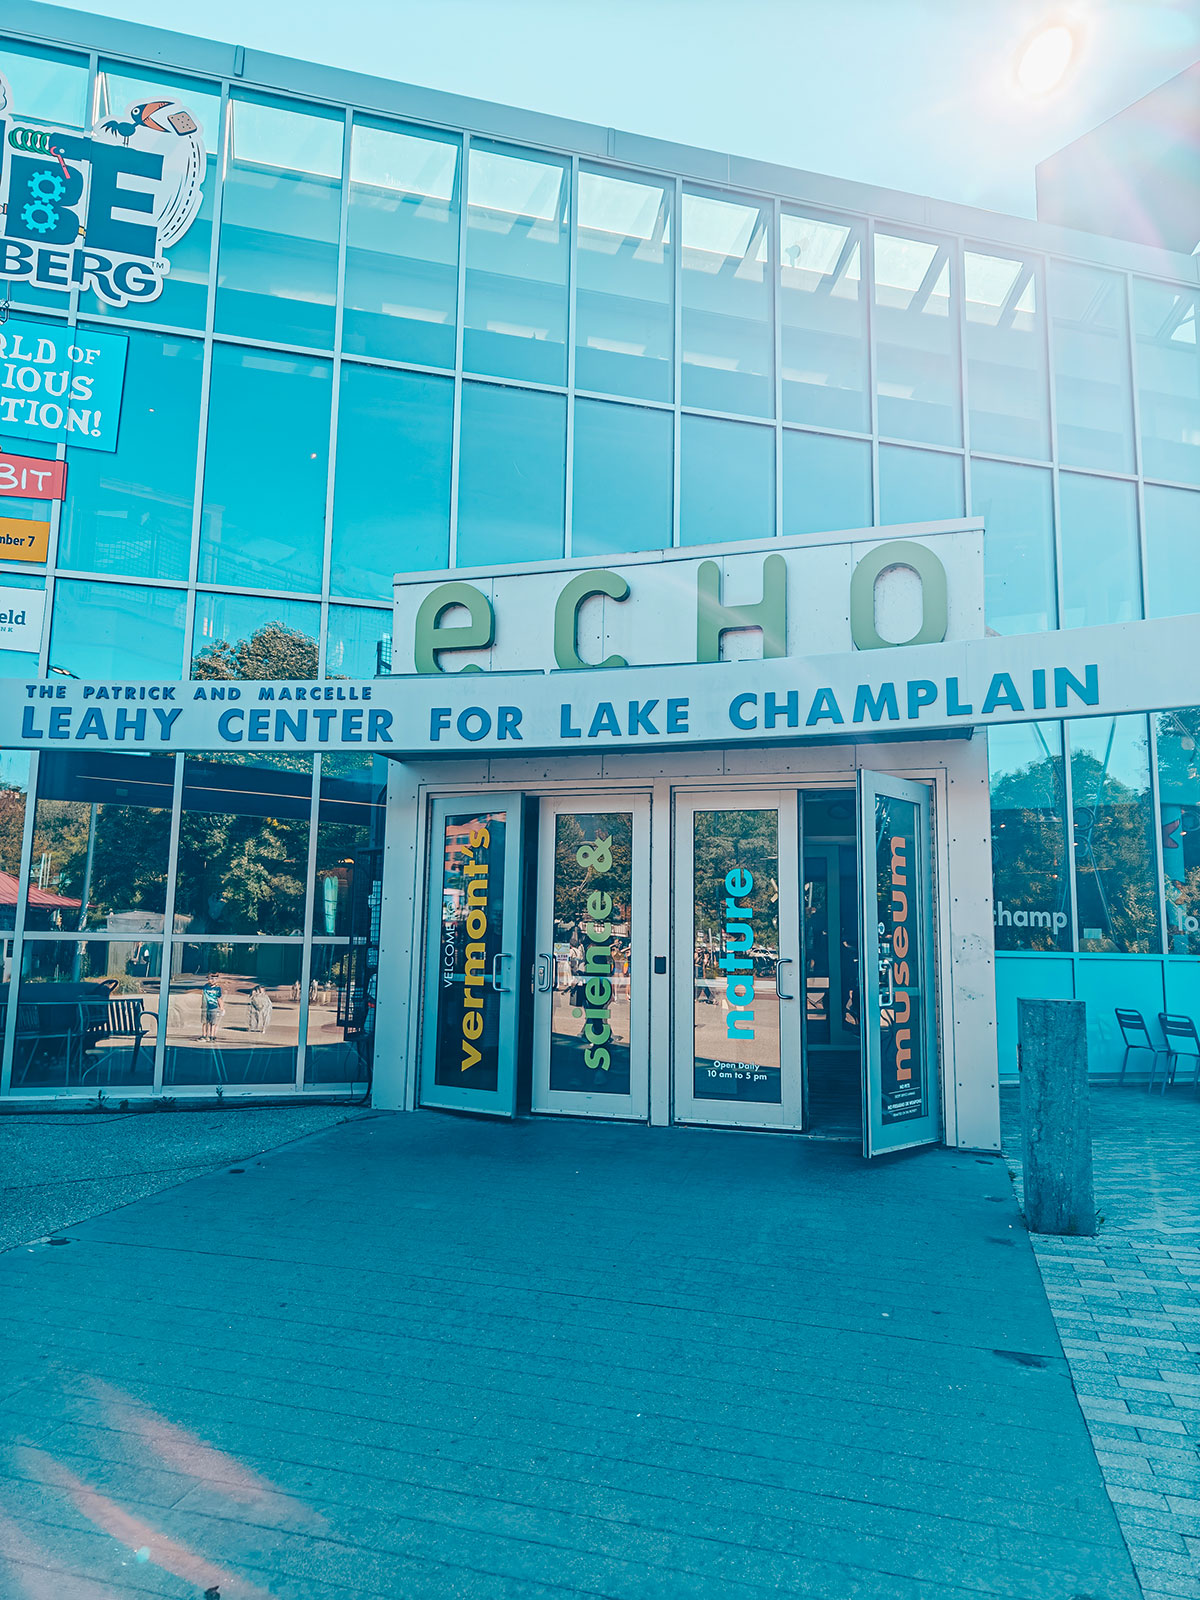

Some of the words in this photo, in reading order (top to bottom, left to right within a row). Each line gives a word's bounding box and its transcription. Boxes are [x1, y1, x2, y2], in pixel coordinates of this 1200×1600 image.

[0, 120, 164, 259] BE
[67, 344, 101, 365] OF
[1, 363, 94, 401] IOUS
[0, 396, 102, 438] TION!
[28, 535, 36, 548] 7
[21, 705, 183, 741] LEAHY
[217, 707, 394, 743] CENTER
[429, 705, 523, 742] FOR
[560, 696, 691, 739] LAKE
[729, 663, 1101, 732] CHAMPLAIN
[26, 684, 67, 700] THE
[83, 685, 177, 701] PATRICK
[193, 686, 242, 701] AND
[259, 686, 373, 701] MARCELLE
[576, 834, 612, 873] &
[993, 901, 1068, 935] hamp
[461, 826, 491, 1072] vermont's
[719, 867, 755, 1041] nature
[890, 835, 912, 1082] museum
[572, 890, 612, 1071] science
[707, 1069, 717, 1078] 10
[719, 1071, 733, 1079] am
[734, 1071, 743, 1079] to
[745, 1071, 751, 1080] 5
[753, 1074, 768, 1082] pm
[713, 1061, 736, 1070] Open
[738, 1061, 760, 1072] Daily
